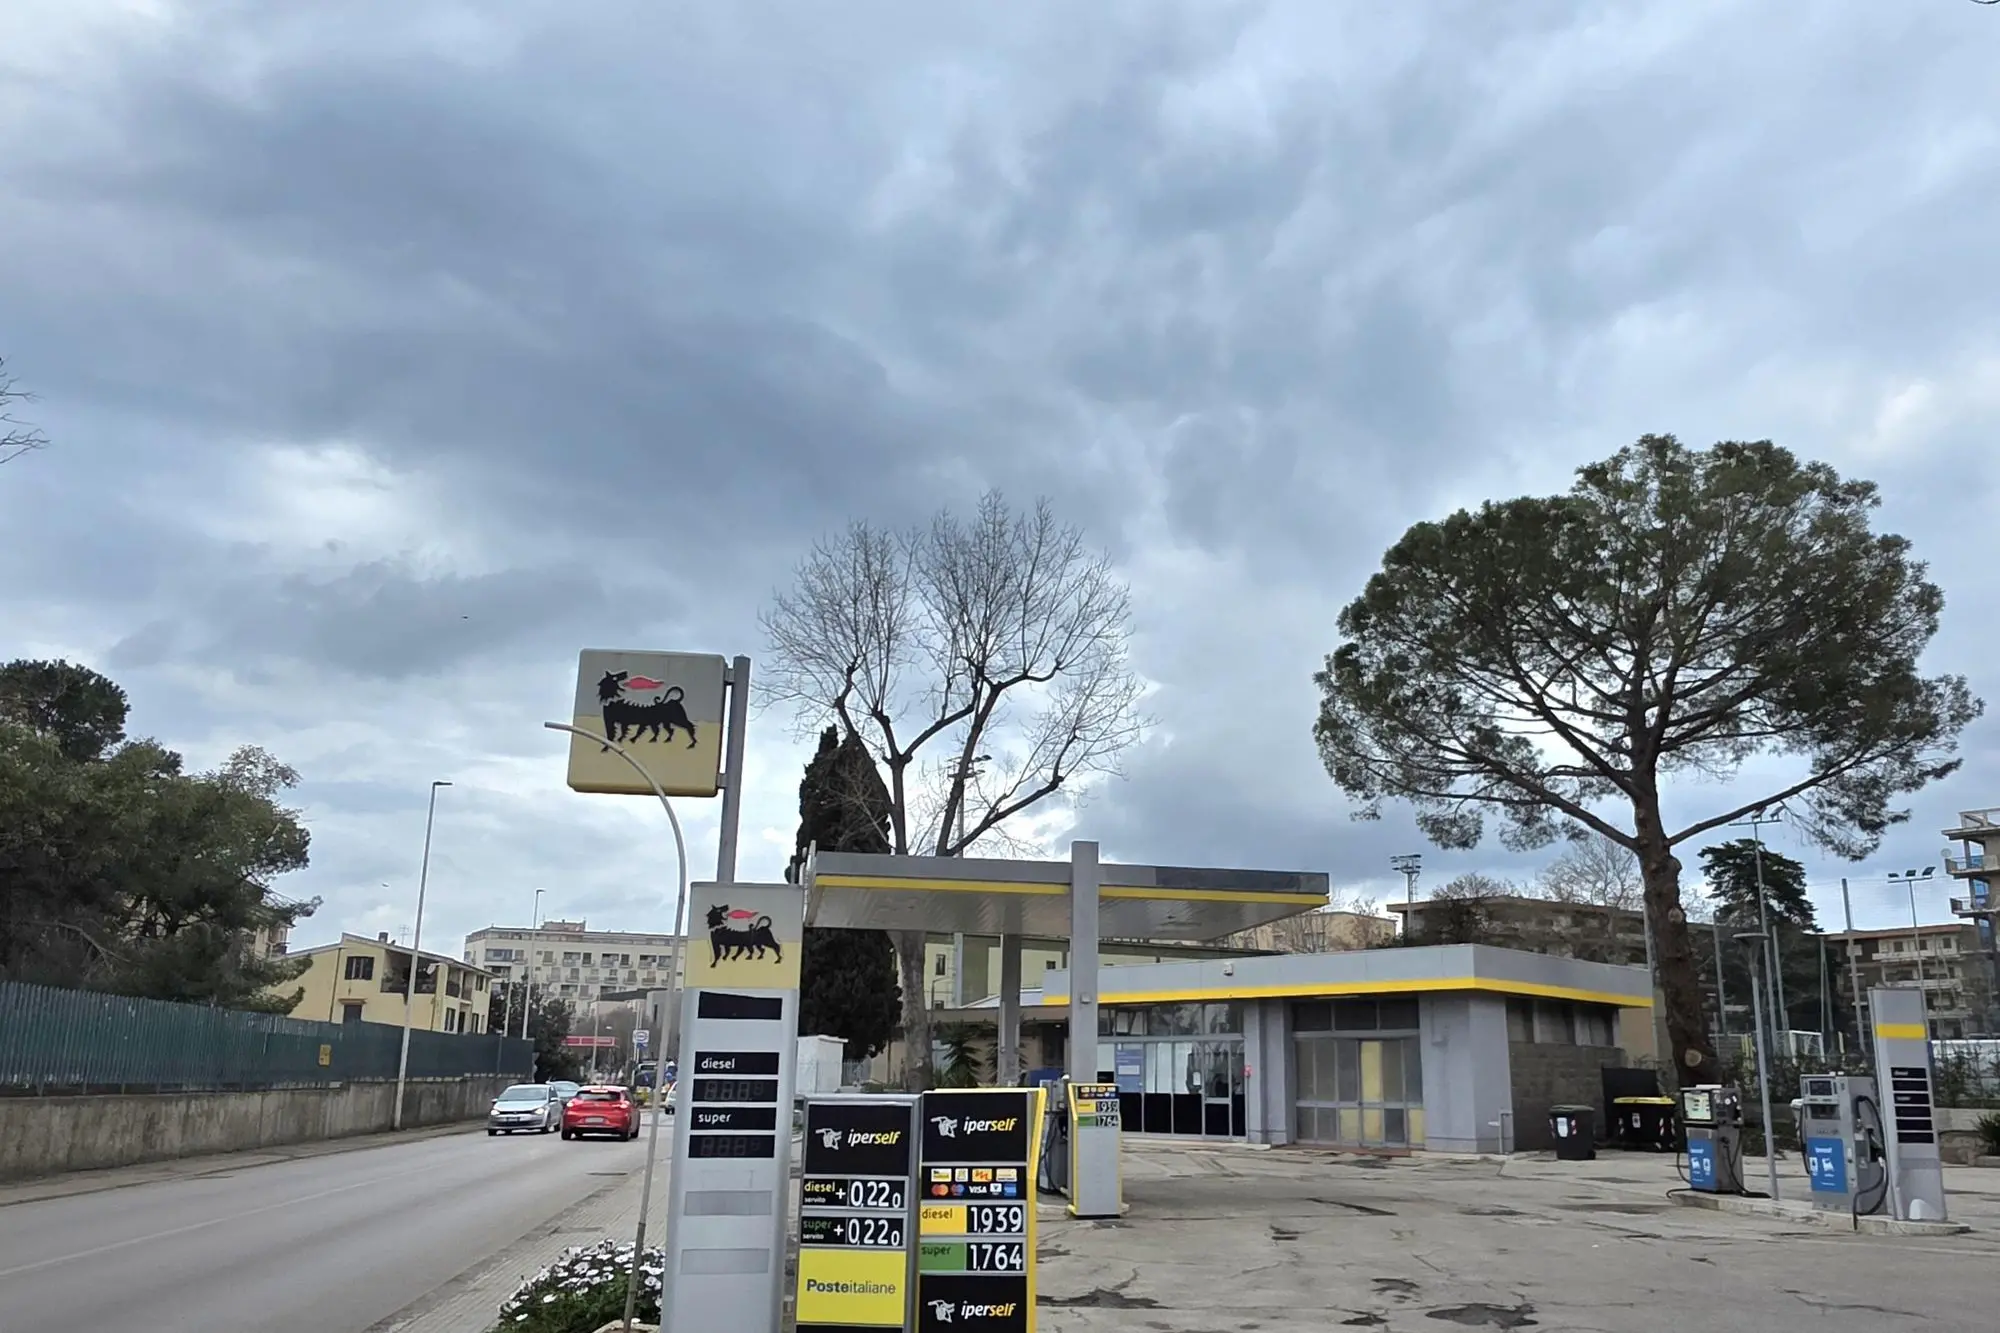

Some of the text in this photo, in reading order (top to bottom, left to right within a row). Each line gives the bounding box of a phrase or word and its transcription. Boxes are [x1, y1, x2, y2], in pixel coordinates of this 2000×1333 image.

[701, 1058, 736, 1069] diesel
[698, 1113, 731, 1125] super
[963, 1116, 1017, 1132] iperself
[847, 1128, 901, 1147] iperself
[804, 1181, 835, 1192] diesel
[969, 1186, 987, 1194] VISA
[922, 1208, 953, 1219] diesel
[803, 1220, 832, 1231] super
[921, 1246, 952, 1257] super
[961, 1300, 1016, 1320] iperself
